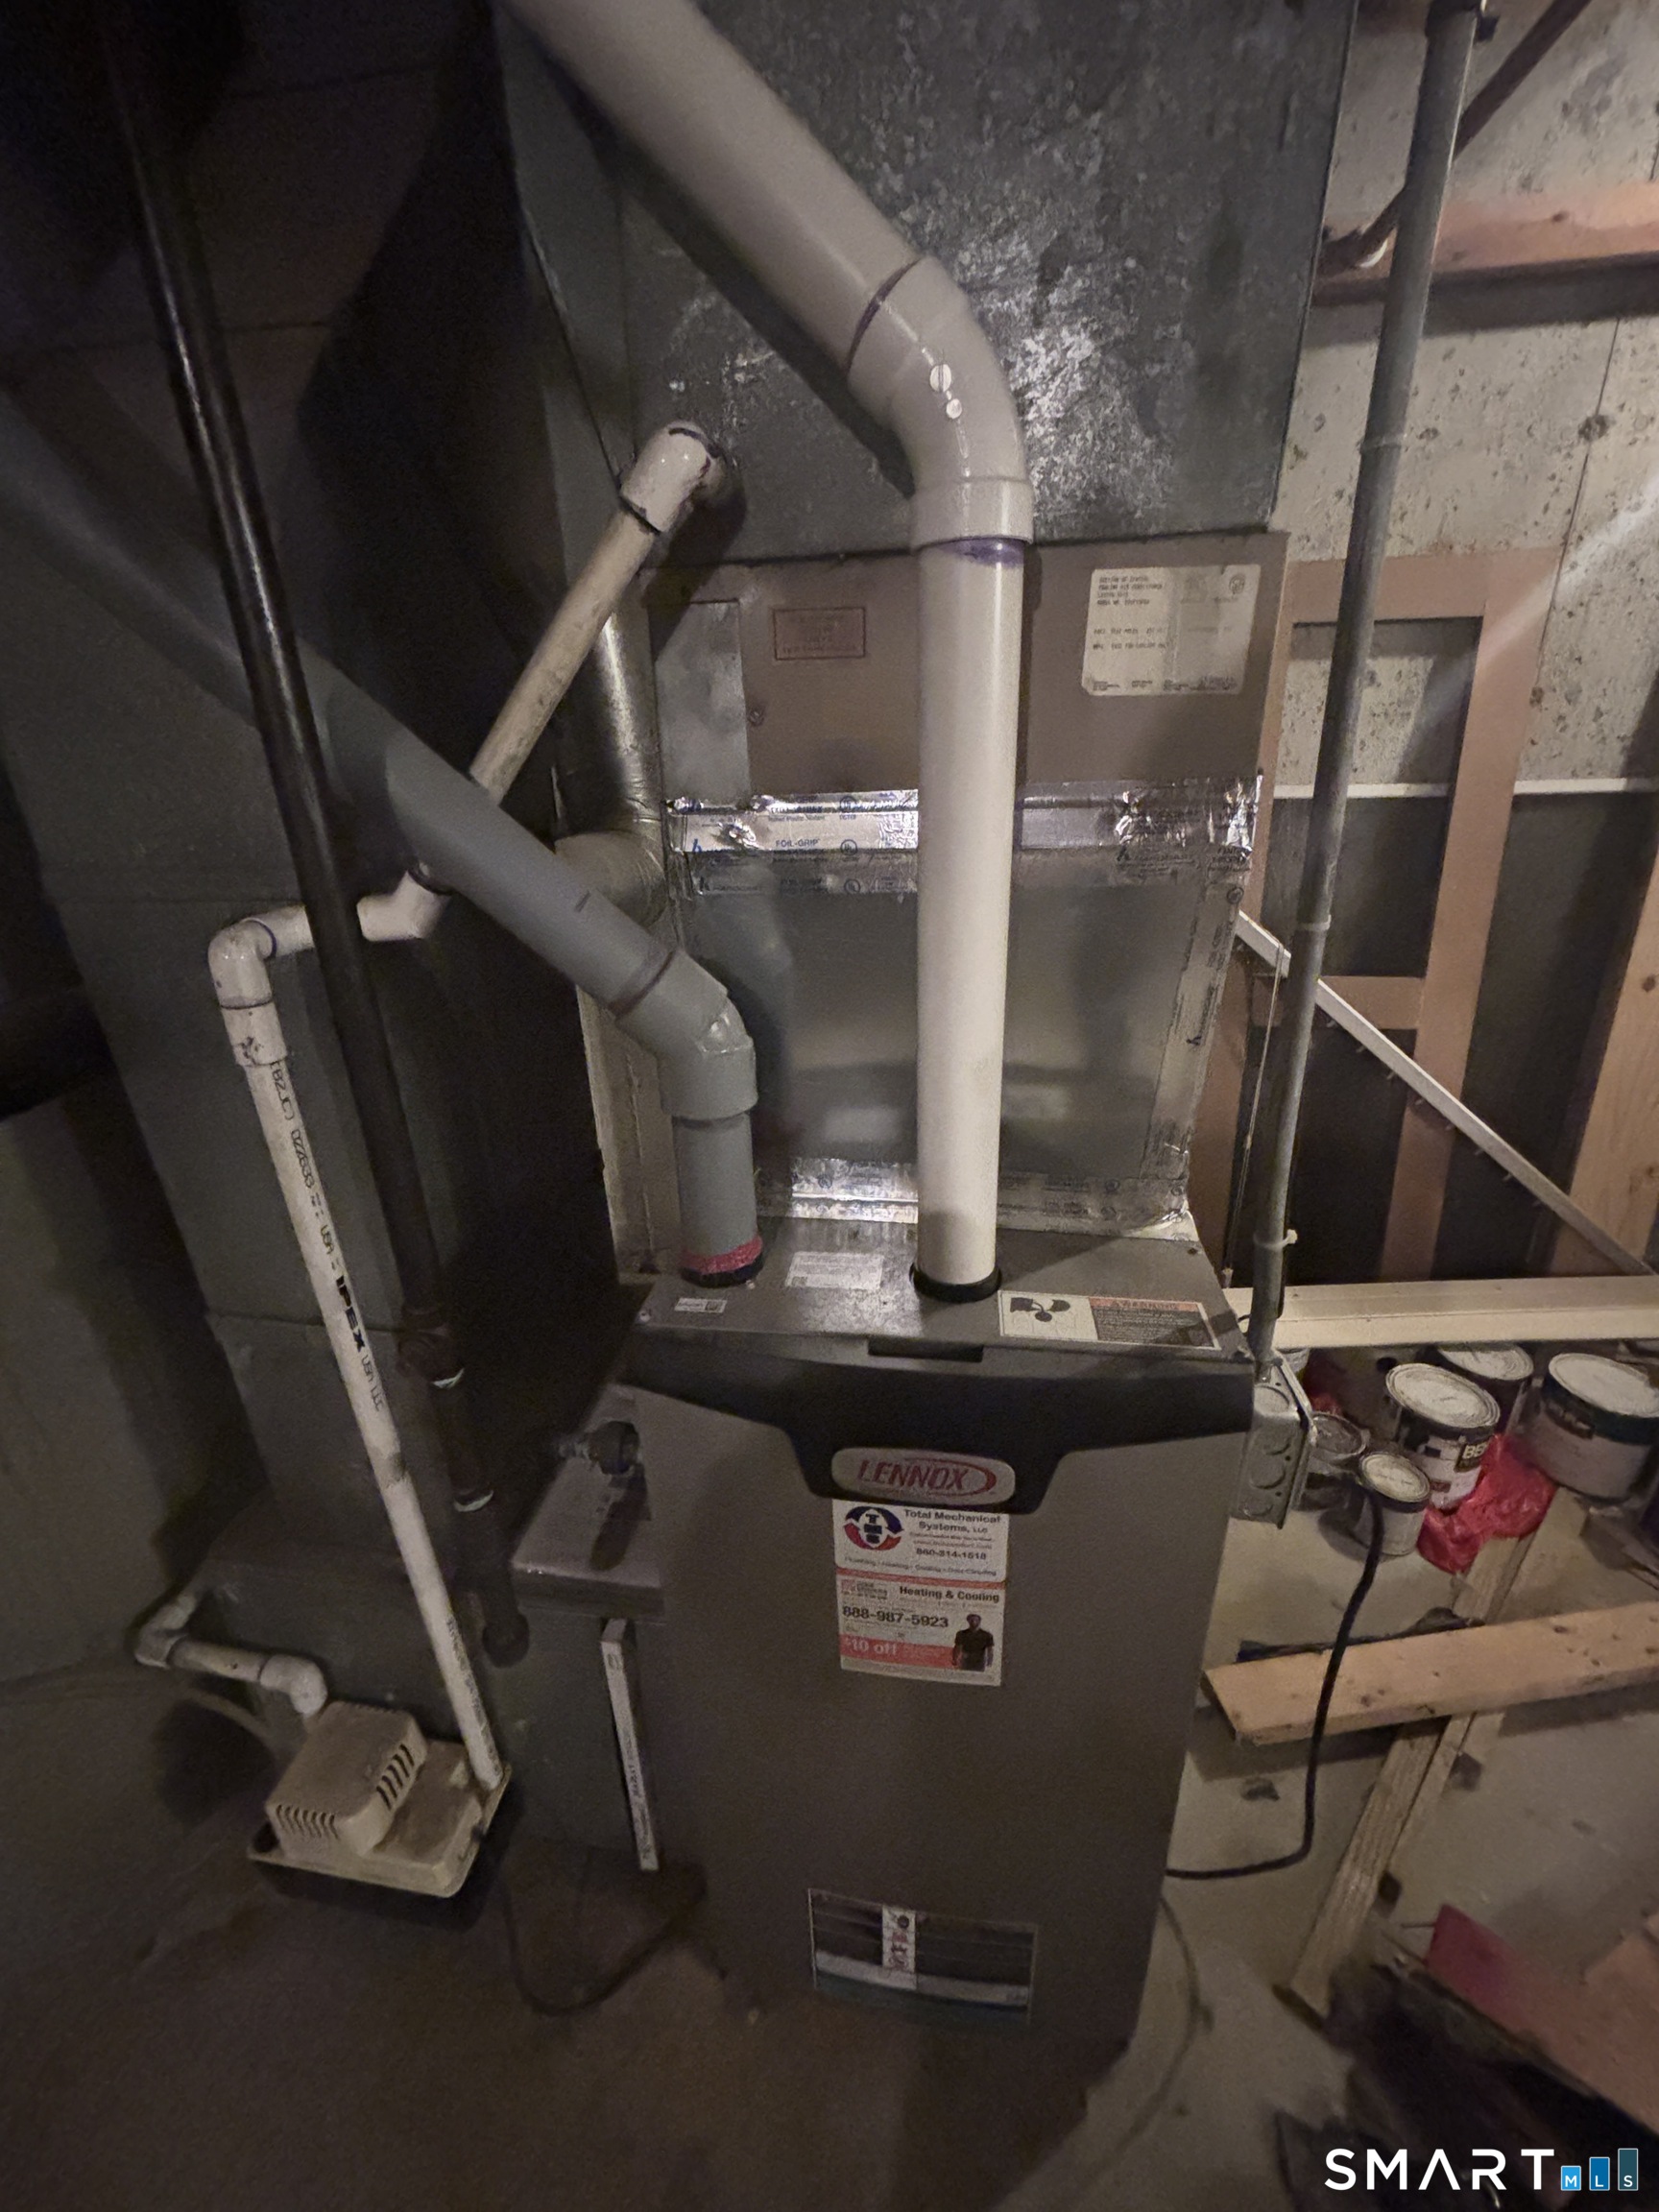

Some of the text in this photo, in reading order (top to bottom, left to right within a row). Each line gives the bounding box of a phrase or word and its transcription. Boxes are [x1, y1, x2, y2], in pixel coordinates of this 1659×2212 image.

[336, 1275, 366, 1353] IPEX
[857, 1459, 969, 1489] LENNOX
[904, 1509, 1001, 1524] Total Mechanical
[900, 1586, 942, 1599] Heating
[945, 1590, 954, 1599] &
[957, 1591, 999, 1603] Cooling
[842, 1605, 949, 1628] 888-987-5923
[874, 1643, 898, 1655] off
